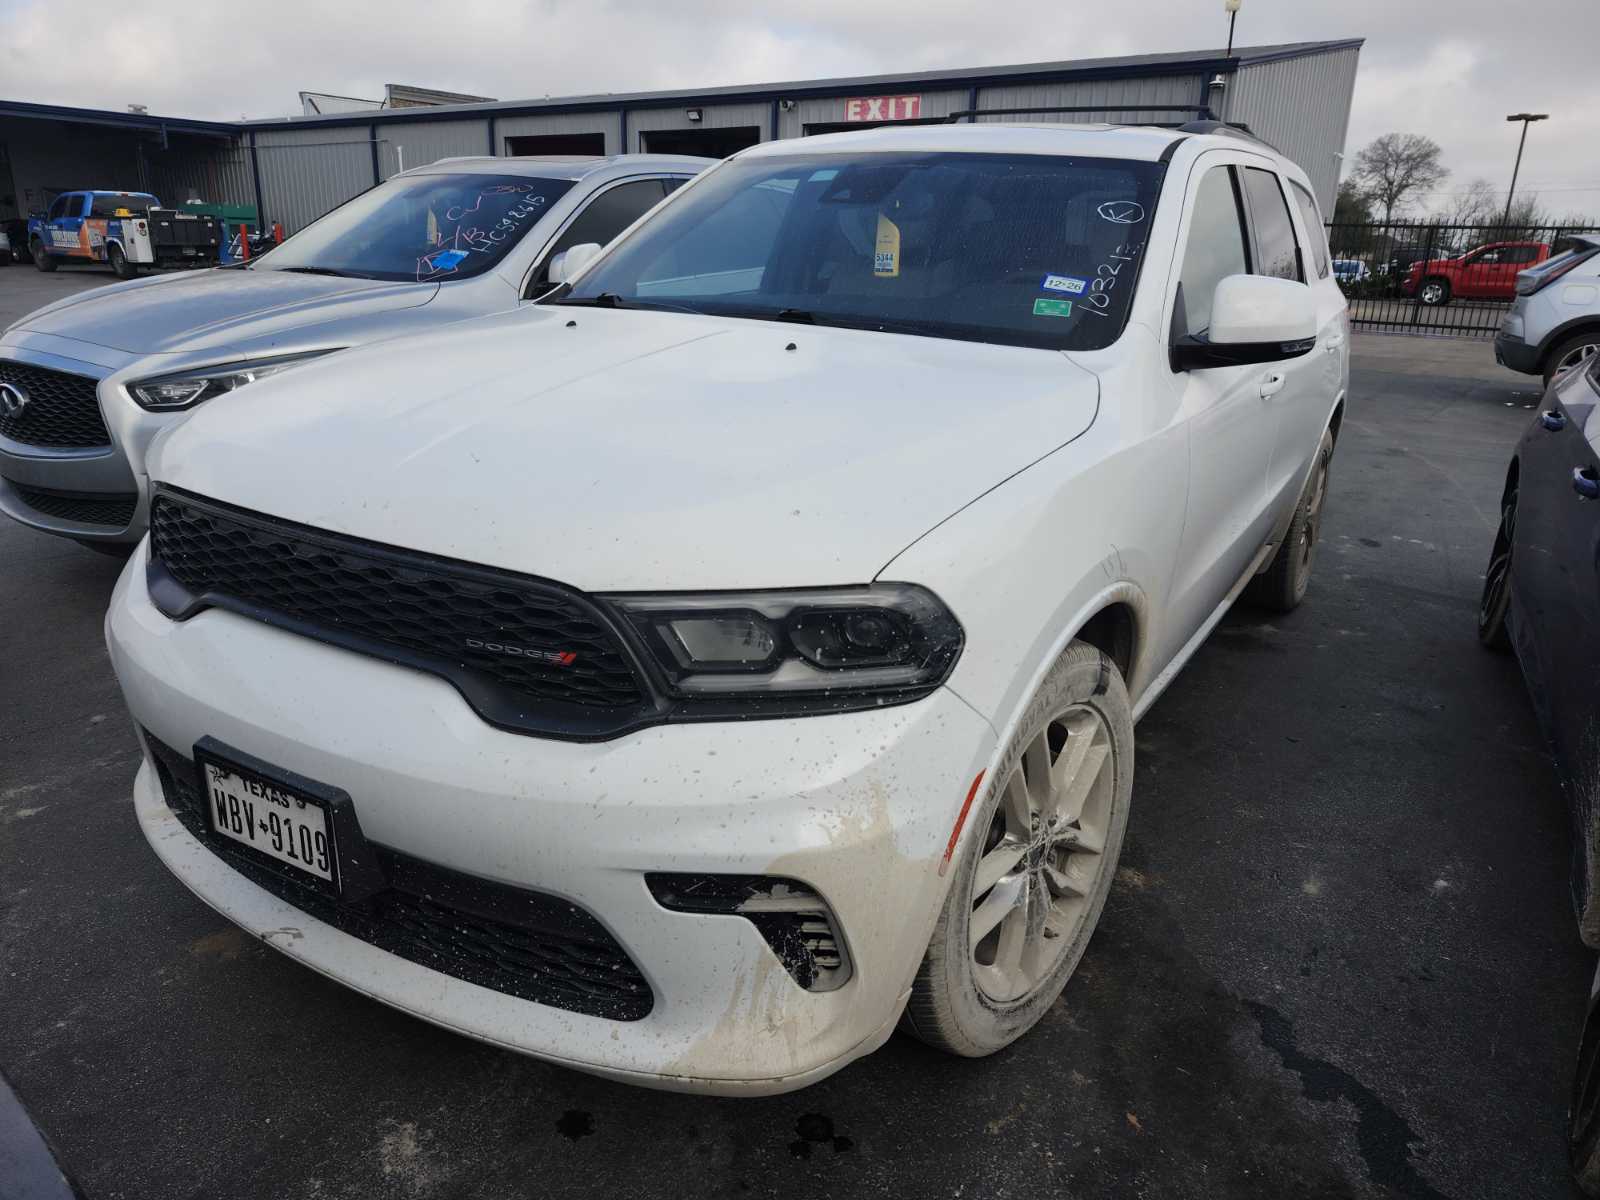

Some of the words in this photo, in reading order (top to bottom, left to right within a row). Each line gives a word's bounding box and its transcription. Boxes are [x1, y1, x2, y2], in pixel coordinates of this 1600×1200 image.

[847, 96, 918, 121] EXIT
[465, 638, 561, 662] DODGE
[241, 779, 290, 809] TEXAS
